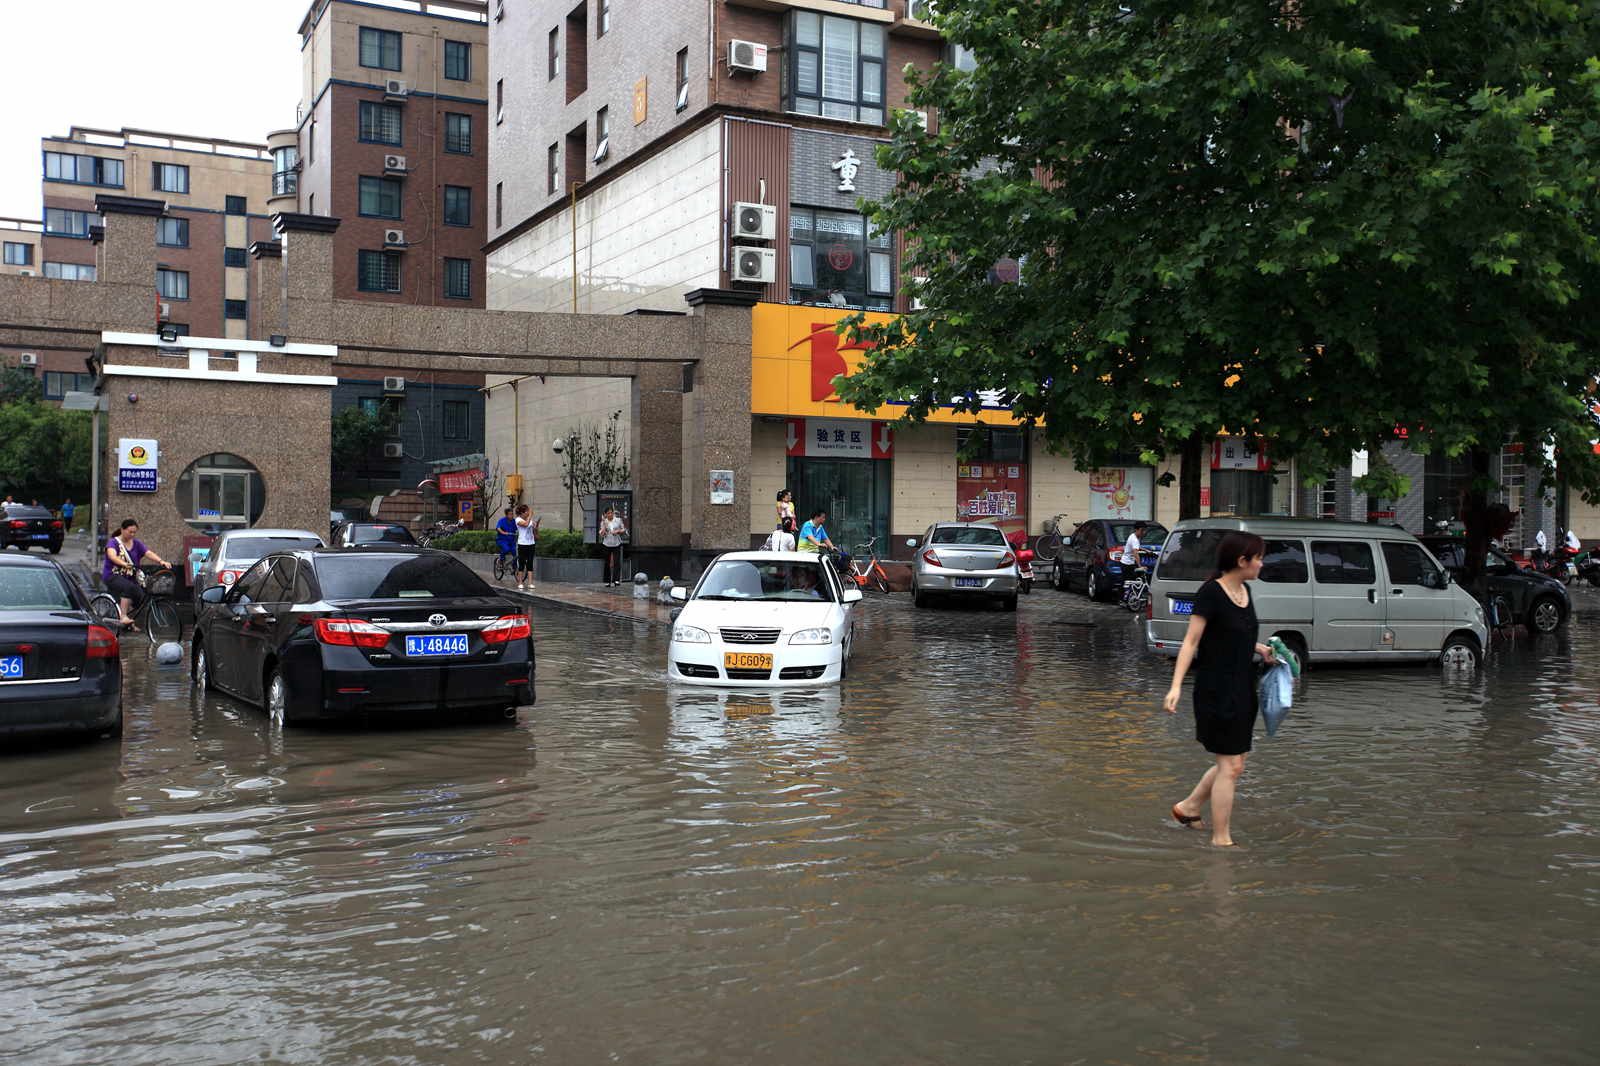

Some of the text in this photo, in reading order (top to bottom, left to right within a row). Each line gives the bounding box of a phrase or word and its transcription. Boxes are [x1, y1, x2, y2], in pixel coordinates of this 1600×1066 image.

[831, 148, 861, 192] 重
[816, 428, 862, 443] 验货区
[461, 501, 472, 513] P
